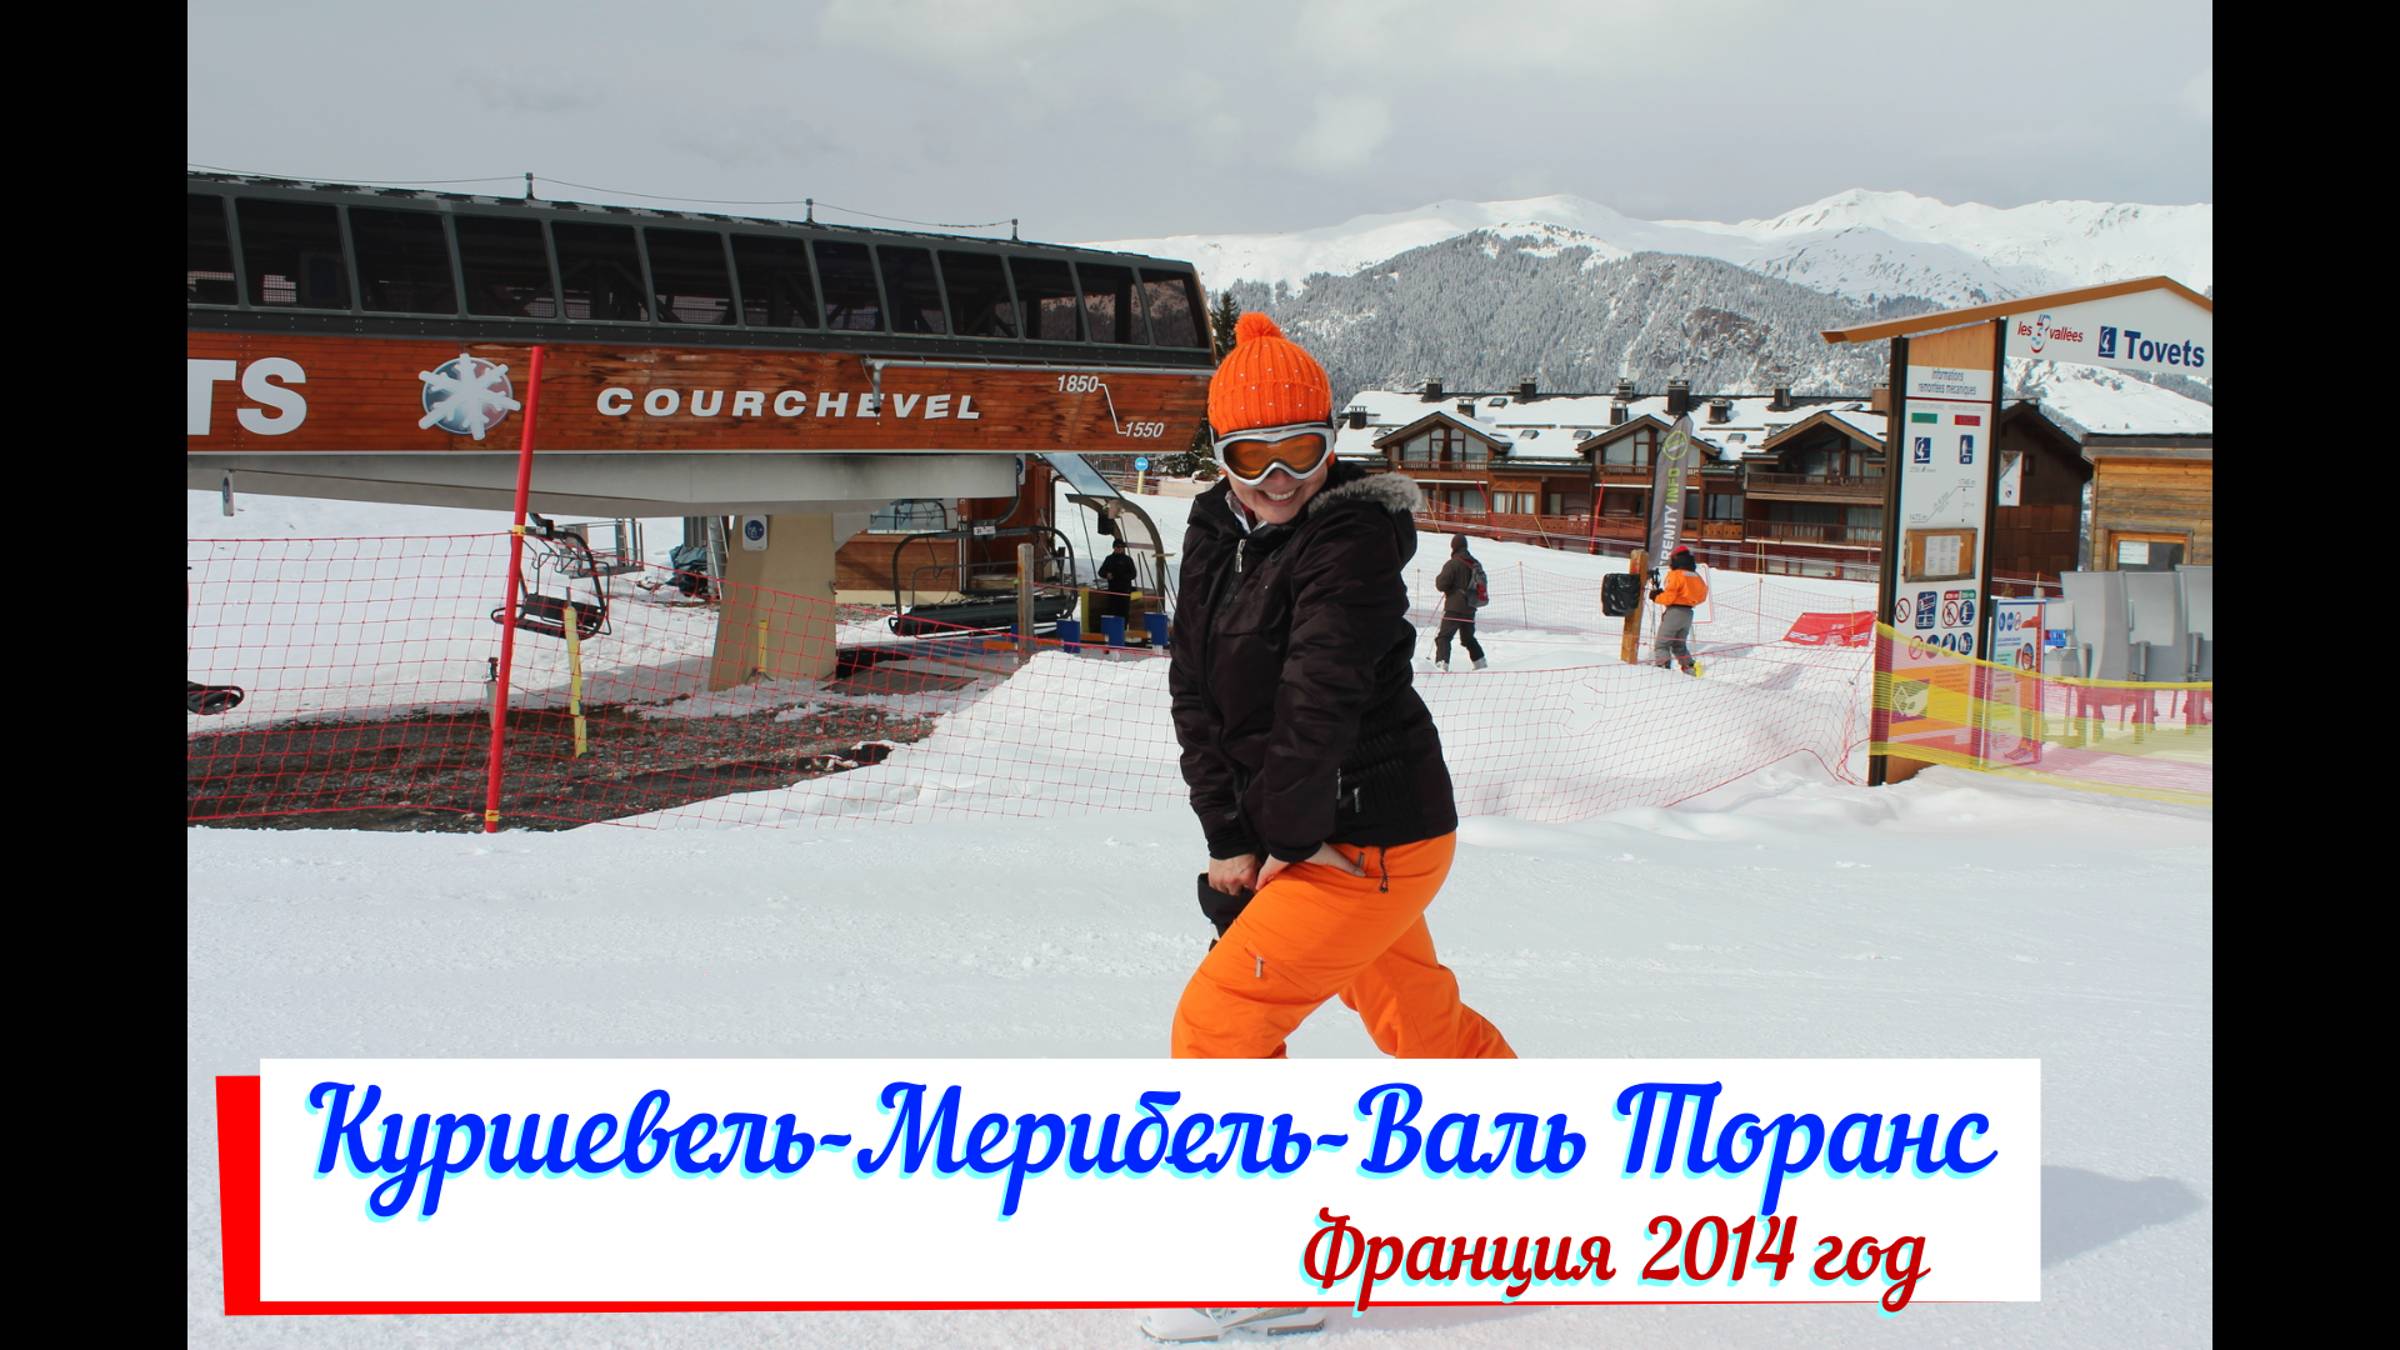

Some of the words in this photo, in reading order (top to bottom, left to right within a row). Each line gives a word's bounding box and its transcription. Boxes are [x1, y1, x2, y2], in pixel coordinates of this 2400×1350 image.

[2017, 321, 2033, 337] les
[2049, 326, 2084, 343] vallées
[2124, 330, 2205, 368] Tovets
[1057, 375, 1099, 393] 1850
[596, 387, 981, 421] COURCHEVEL
[1124, 422, 1165, 438] 1550
[1665, 467, 1681, 503] INFO
